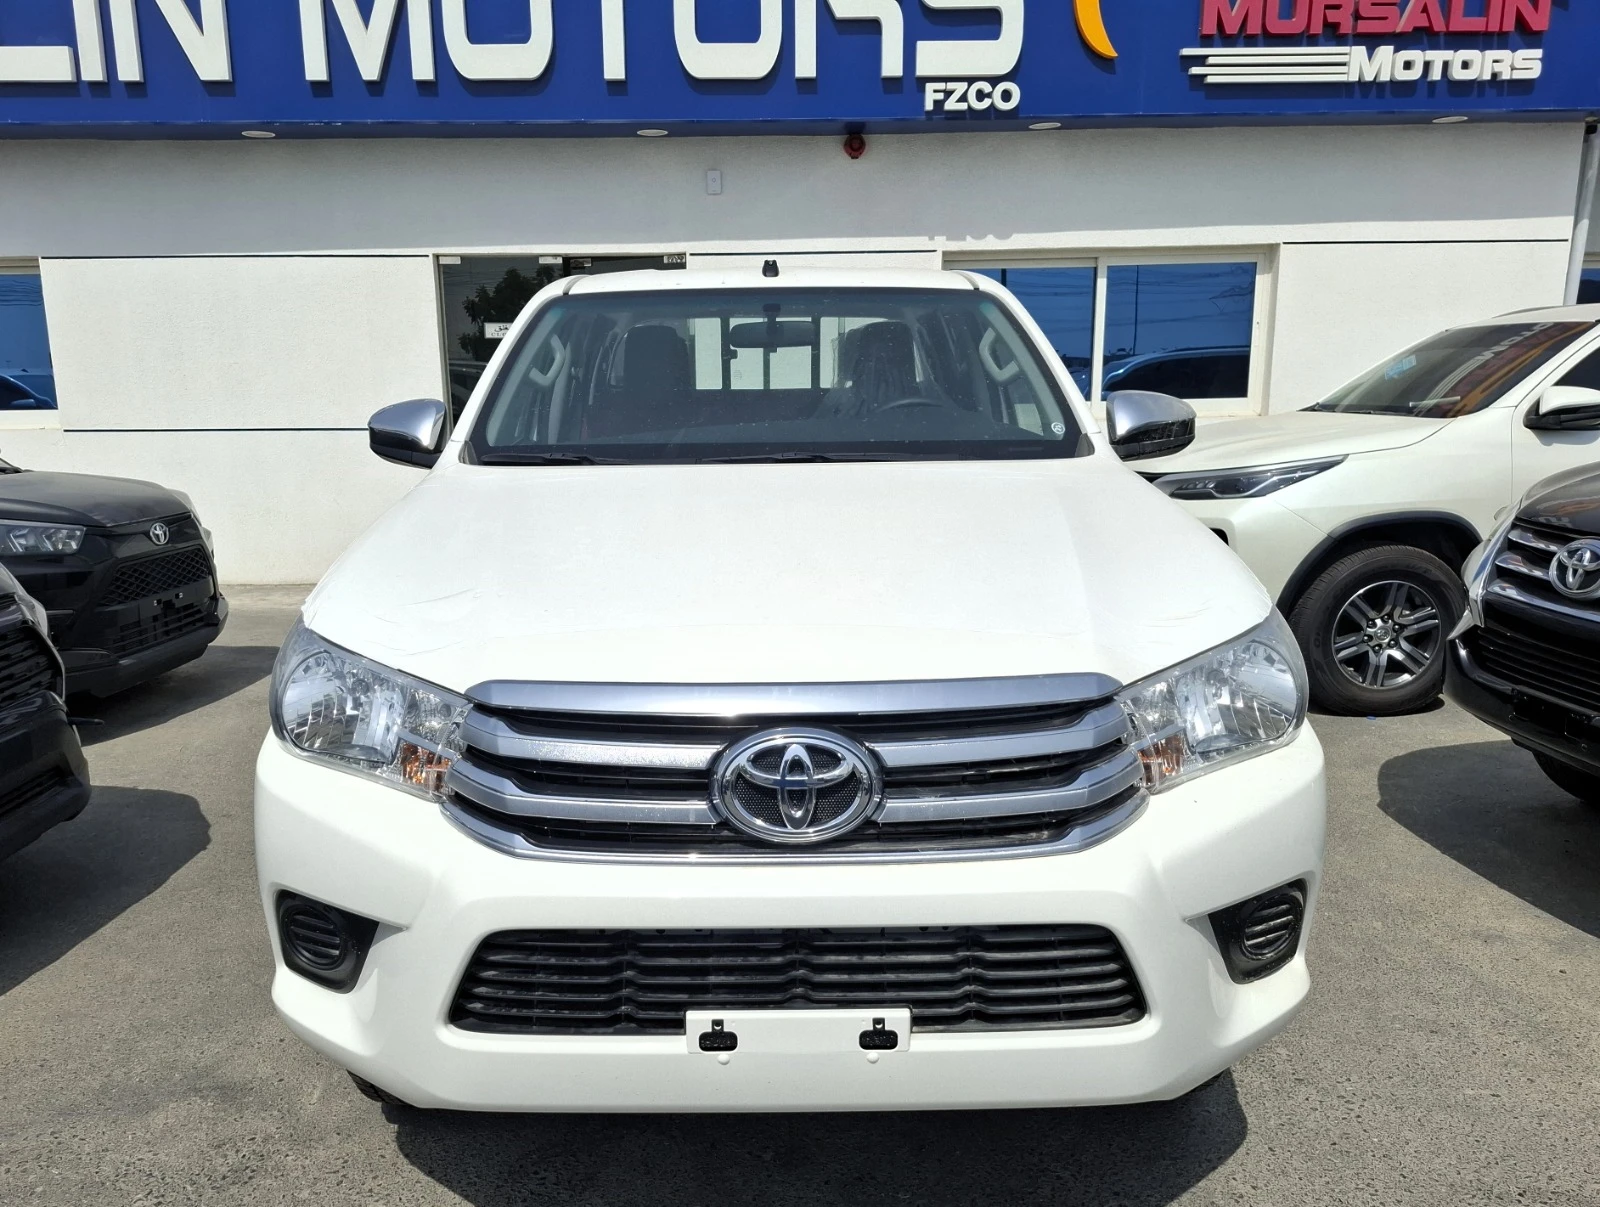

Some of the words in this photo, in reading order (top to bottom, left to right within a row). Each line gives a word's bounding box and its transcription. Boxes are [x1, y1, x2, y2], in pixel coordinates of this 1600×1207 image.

[1200, 0, 1551, 37] MURSALIN
[1348, 45, 1543, 83] MOTORS
[924, 81, 1021, 112] FZCO
